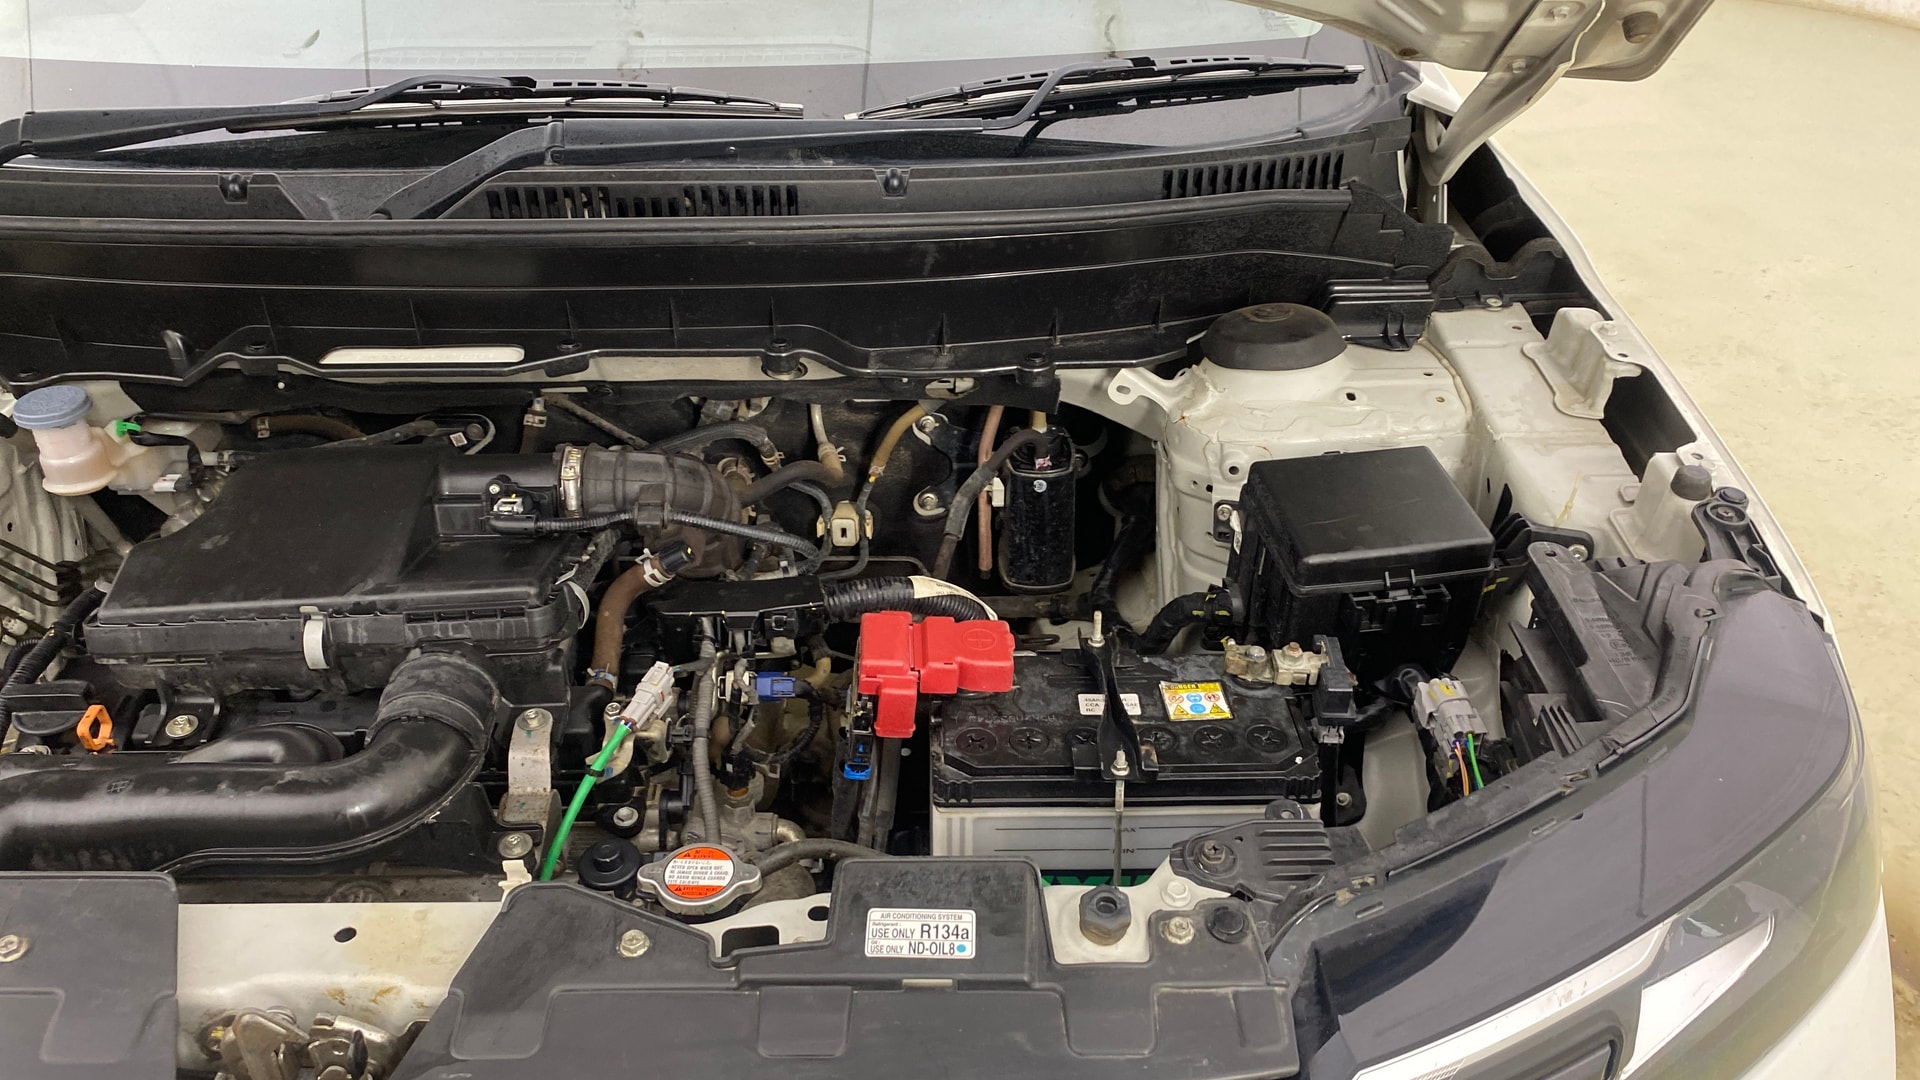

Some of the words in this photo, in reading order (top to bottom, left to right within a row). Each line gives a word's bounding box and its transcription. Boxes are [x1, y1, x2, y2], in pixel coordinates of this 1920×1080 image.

[871, 928, 889, 938] USE
[891, 928, 916, 938] ONLY
[920, 923, 969, 940] R134a
[870, 945, 884, 954] USE
[885, 945, 904, 954] ONLY
[908, 941, 956, 956] ND-OIL8
